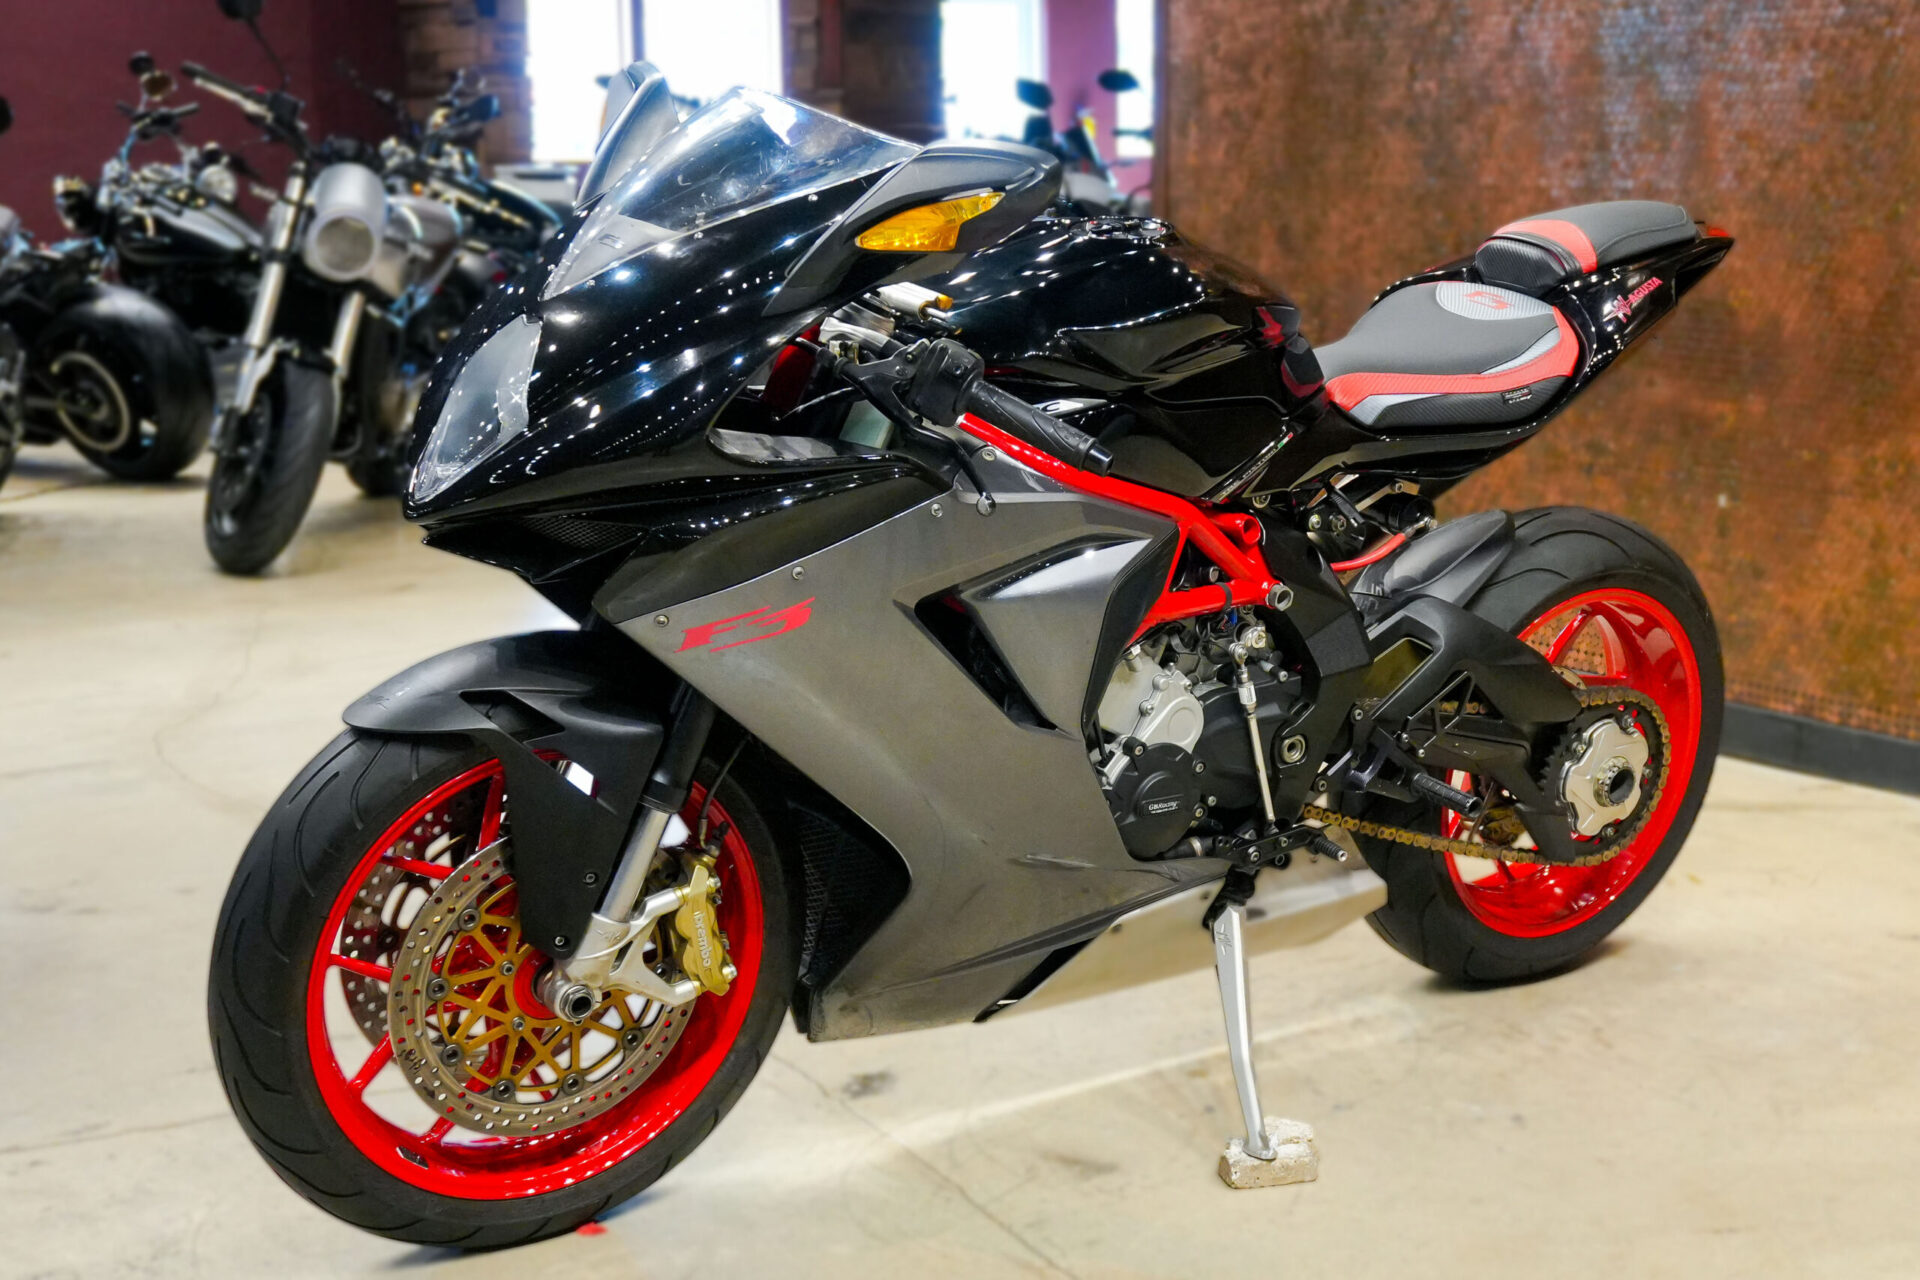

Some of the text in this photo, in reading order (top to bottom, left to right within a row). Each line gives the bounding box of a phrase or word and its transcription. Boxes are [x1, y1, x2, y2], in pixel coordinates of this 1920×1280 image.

[1628, 277, 1663, 303] AGUSTA
[674, 597, 816, 653] F3
[694, 911, 712, 967] brembo
